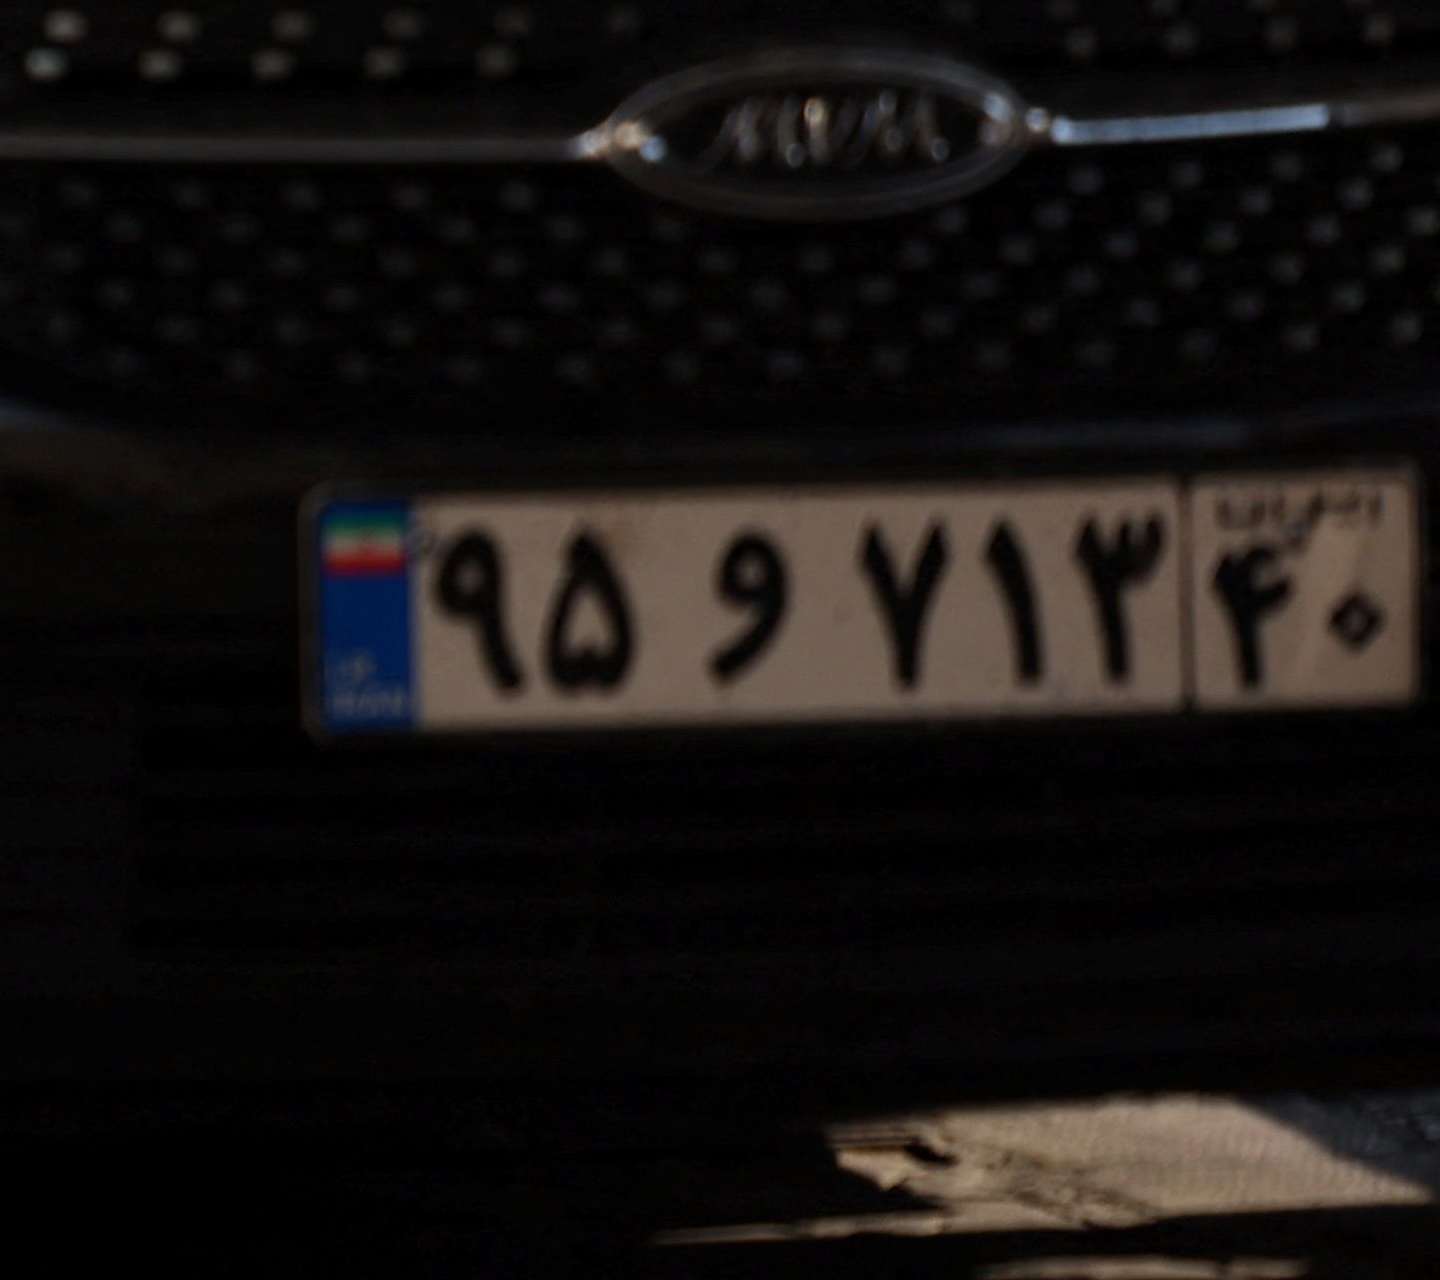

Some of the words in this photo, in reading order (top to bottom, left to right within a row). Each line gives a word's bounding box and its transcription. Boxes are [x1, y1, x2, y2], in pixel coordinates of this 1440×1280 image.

[435, 521, 634, 699] ۹۵
[710, 527, 789, 685] و
[862, 509, 1164, 689] ۷۱۳
[1213, 544, 1386, 691] ۴۰
